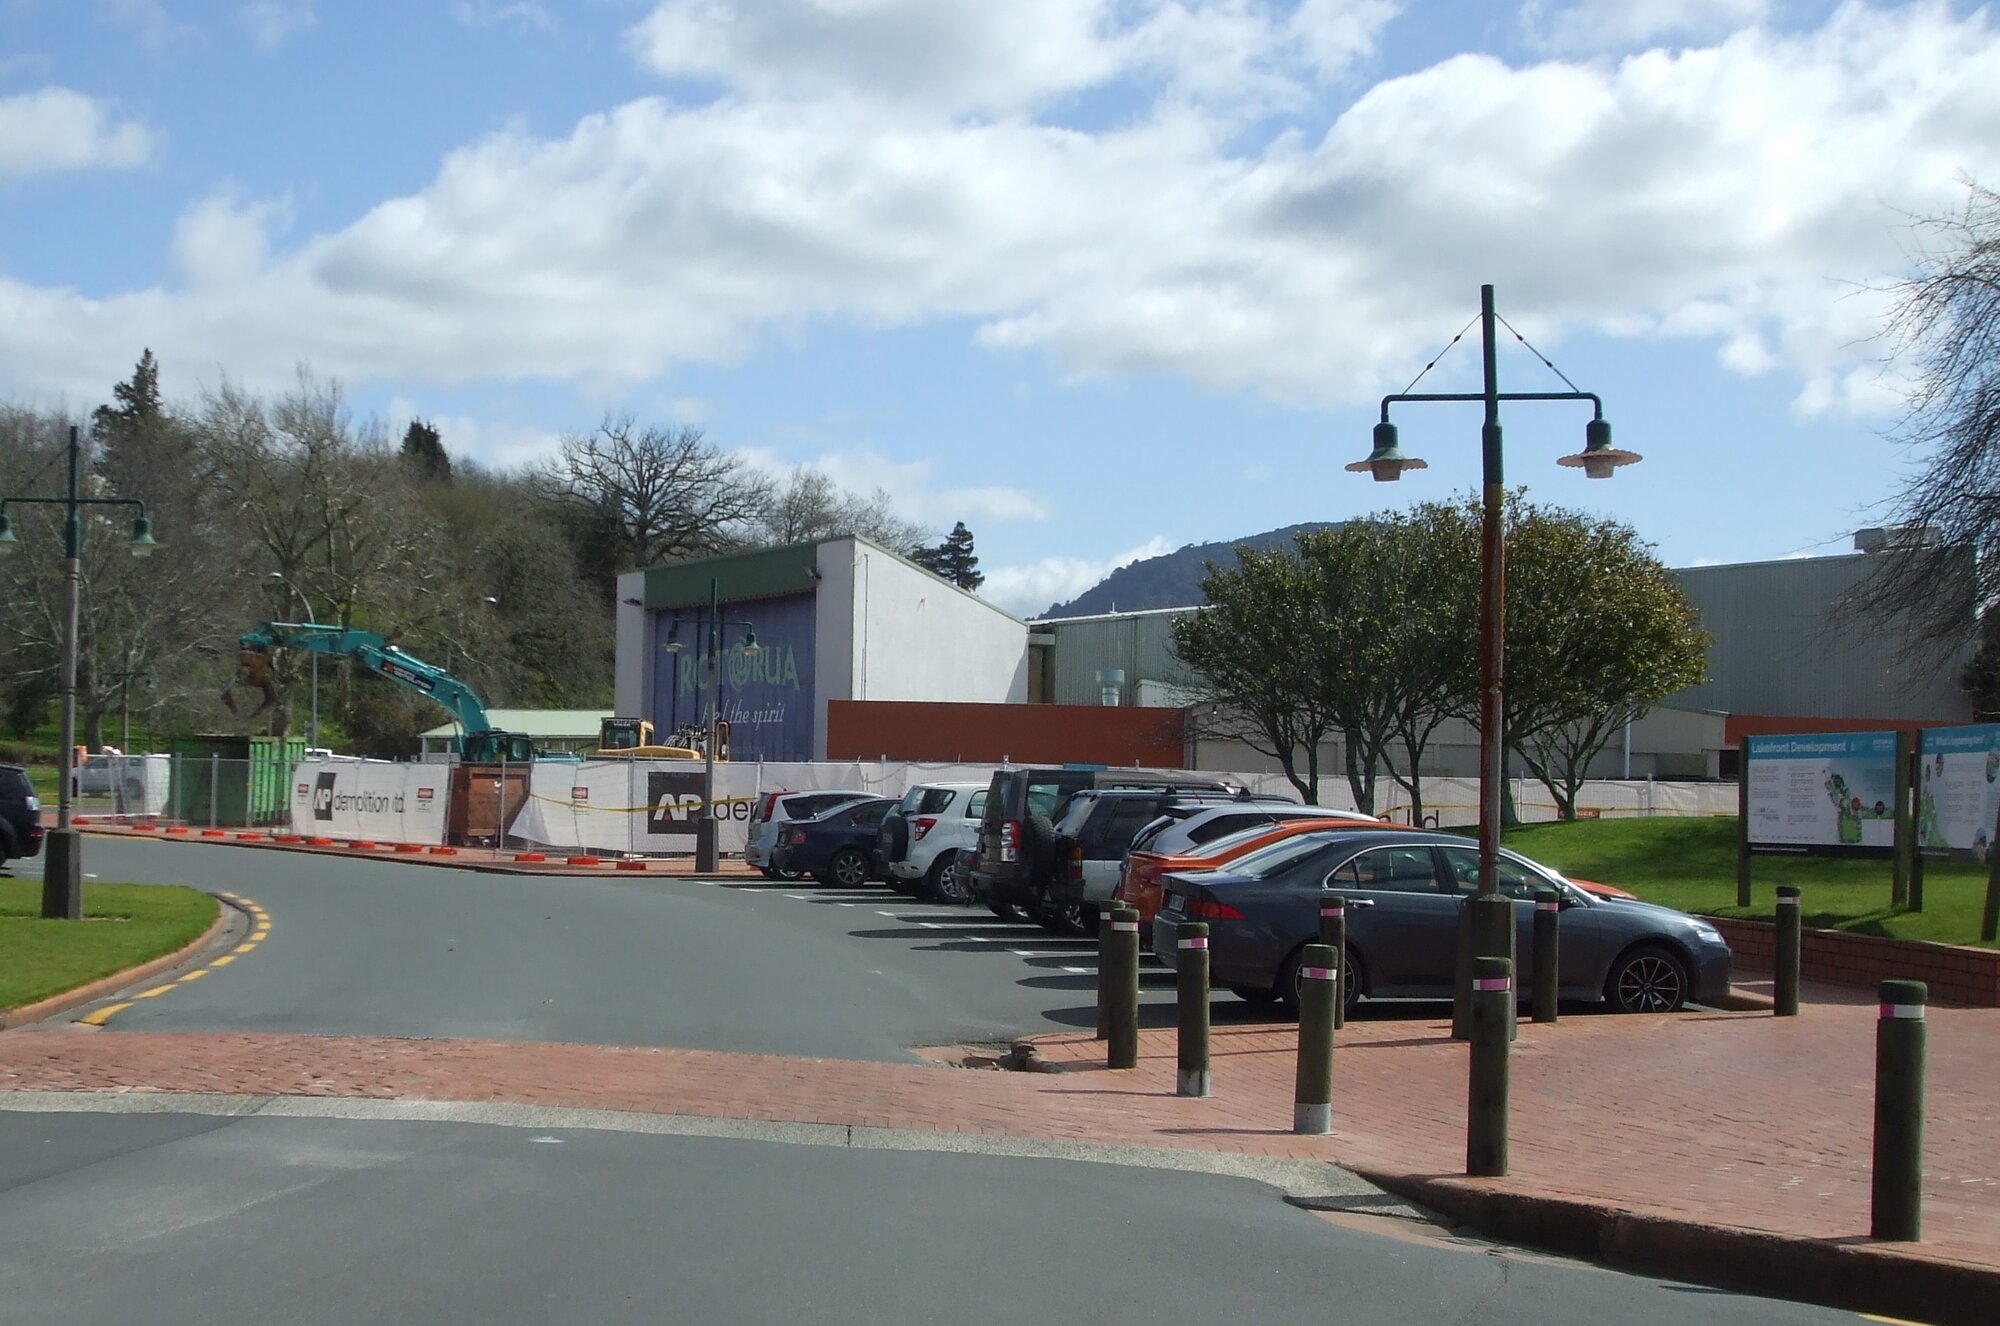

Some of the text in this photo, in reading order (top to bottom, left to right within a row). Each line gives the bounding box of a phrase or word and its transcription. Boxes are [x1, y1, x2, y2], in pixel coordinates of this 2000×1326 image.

[730, 699, 750, 724] the
[752, 702, 785, 731] spirit
[1752, 742, 1789, 753] Lakefront
[1791, 740, 1847, 754] Development
[334, 790, 389, 812] demolition
[653, 794, 702, 821] AP
